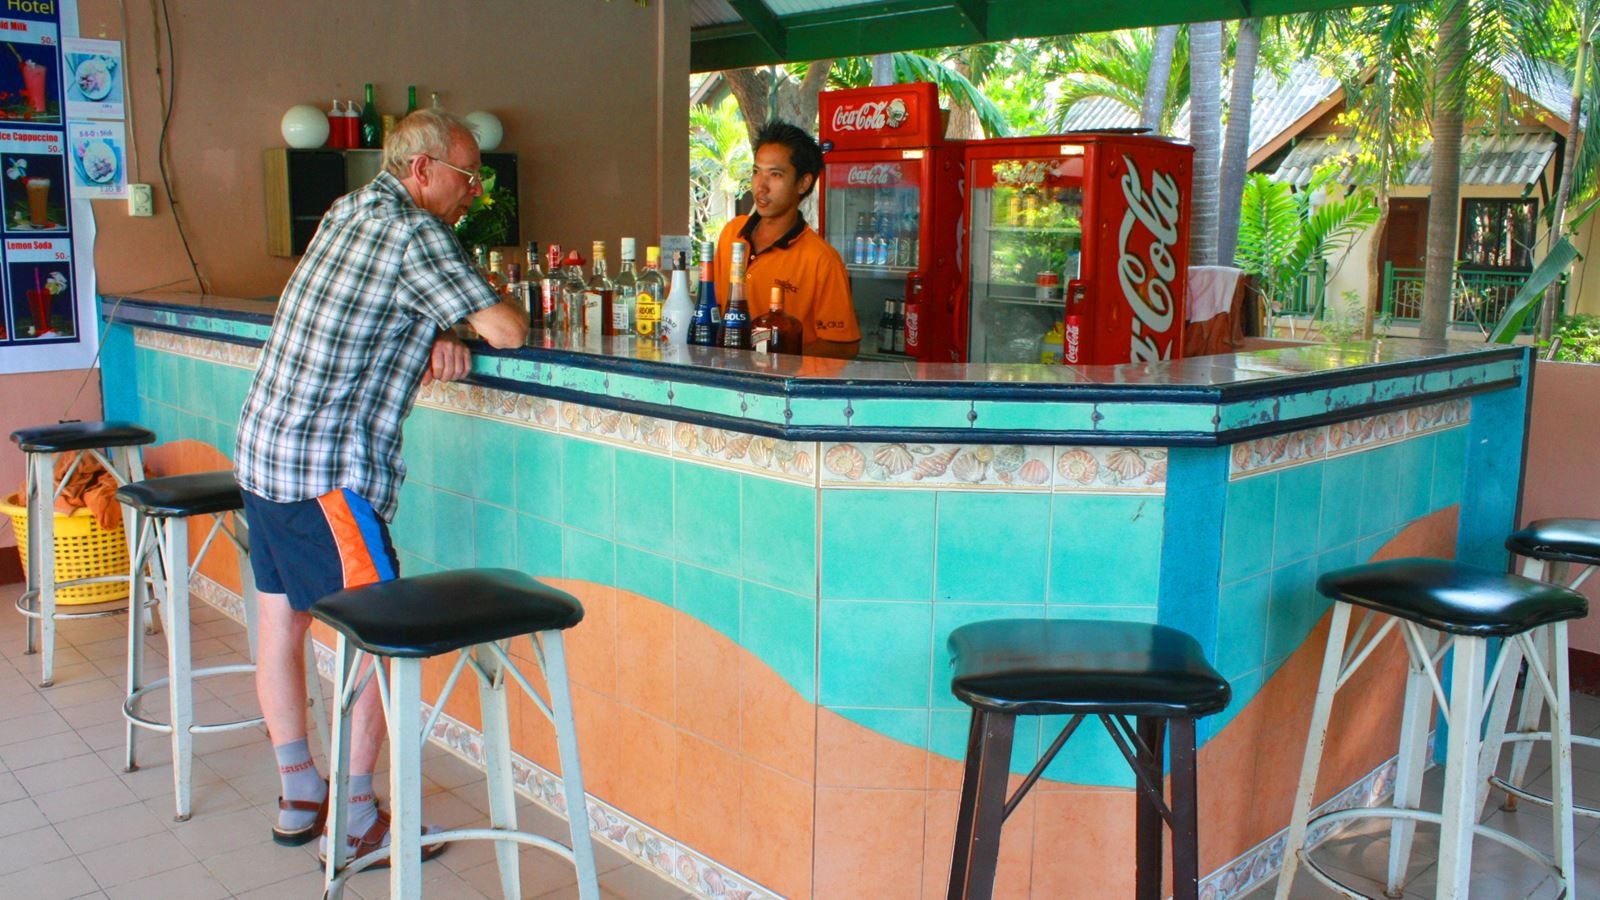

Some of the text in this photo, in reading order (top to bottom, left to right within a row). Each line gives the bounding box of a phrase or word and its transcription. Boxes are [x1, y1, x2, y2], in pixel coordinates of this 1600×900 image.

[7, 0, 55, 15] Hotel
[11, 21, 28, 32] Milk
[832, 101, 888, 132] Coca-Cola
[13, 132, 58, 143] Cappuccino
[7, 241, 53, 250] Lemon Soda
[724, 312, 747, 321] BOLS
